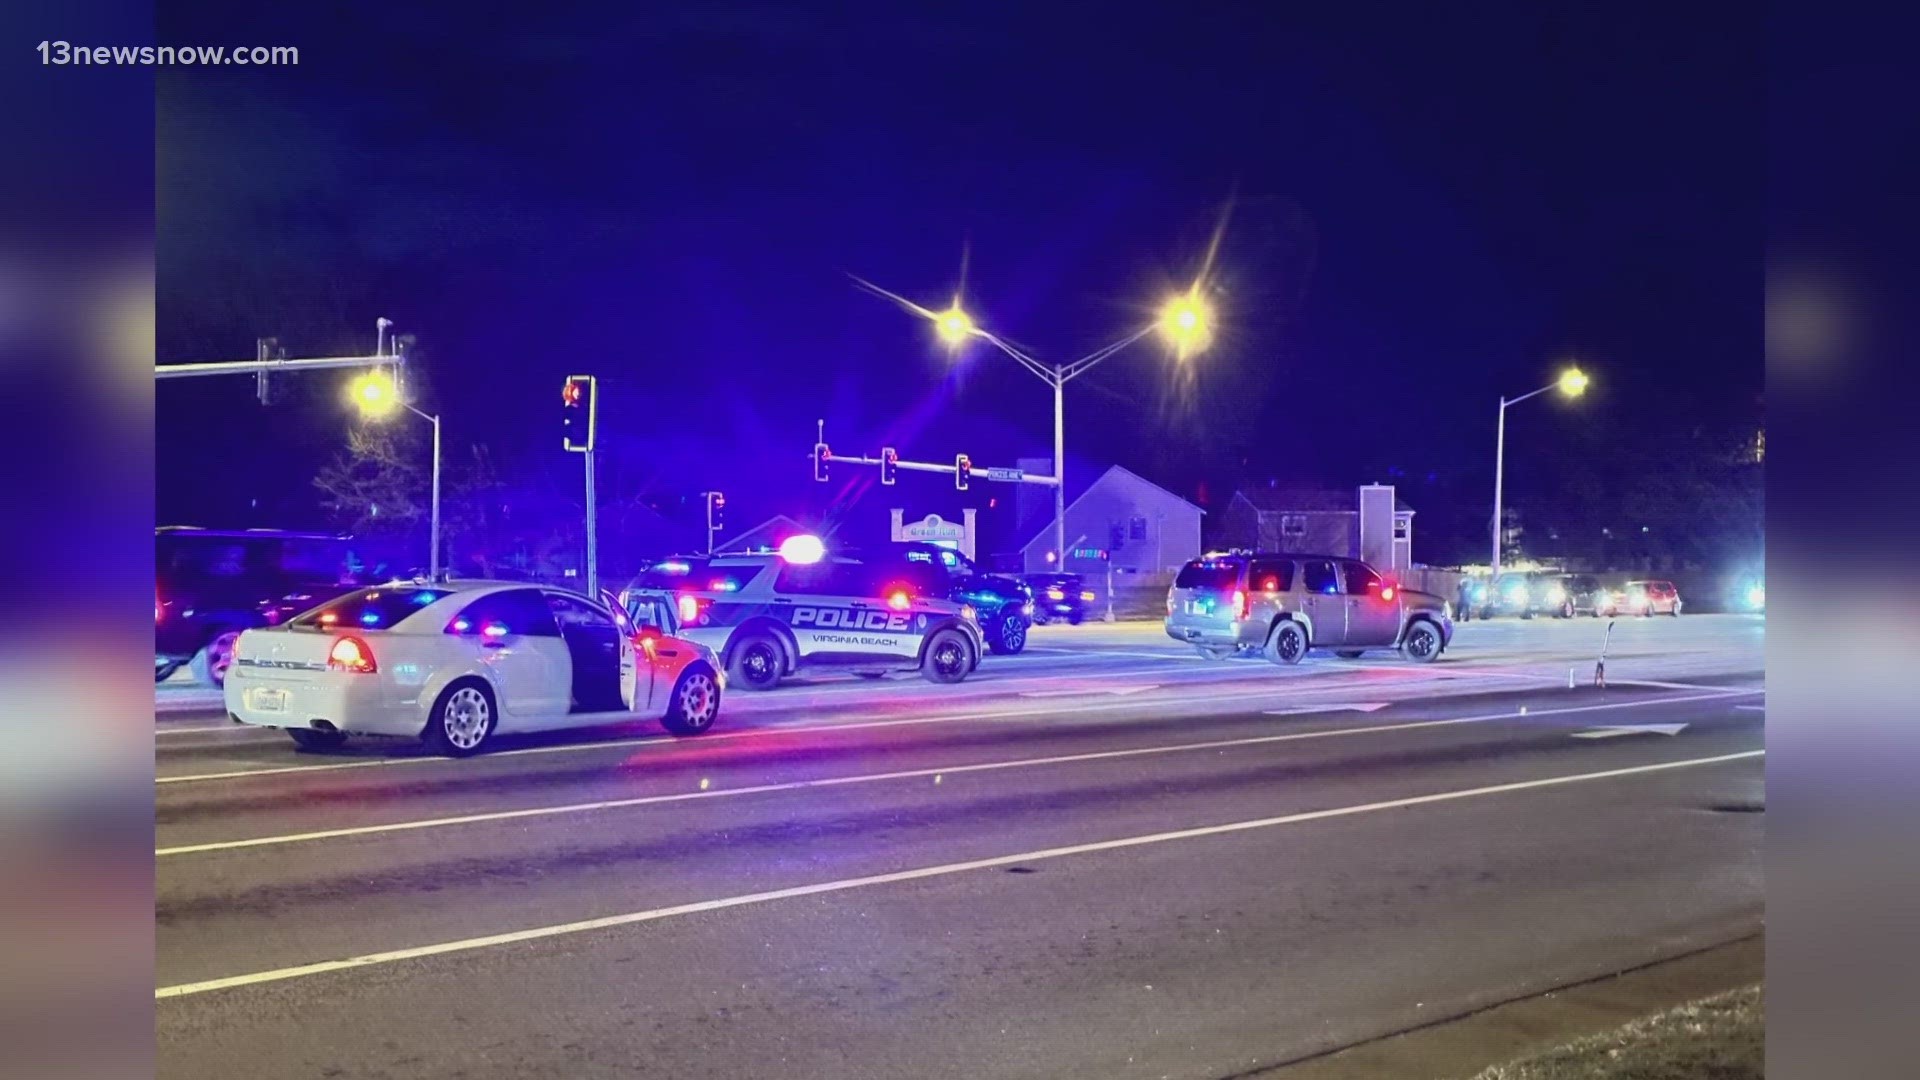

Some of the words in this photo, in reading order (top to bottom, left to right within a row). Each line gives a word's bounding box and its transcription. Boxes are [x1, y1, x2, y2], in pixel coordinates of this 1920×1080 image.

[791, 607, 911, 631] POLICE
[813, 634, 859, 645] VIRGINIA
[860, 637, 898, 647] BEACH
